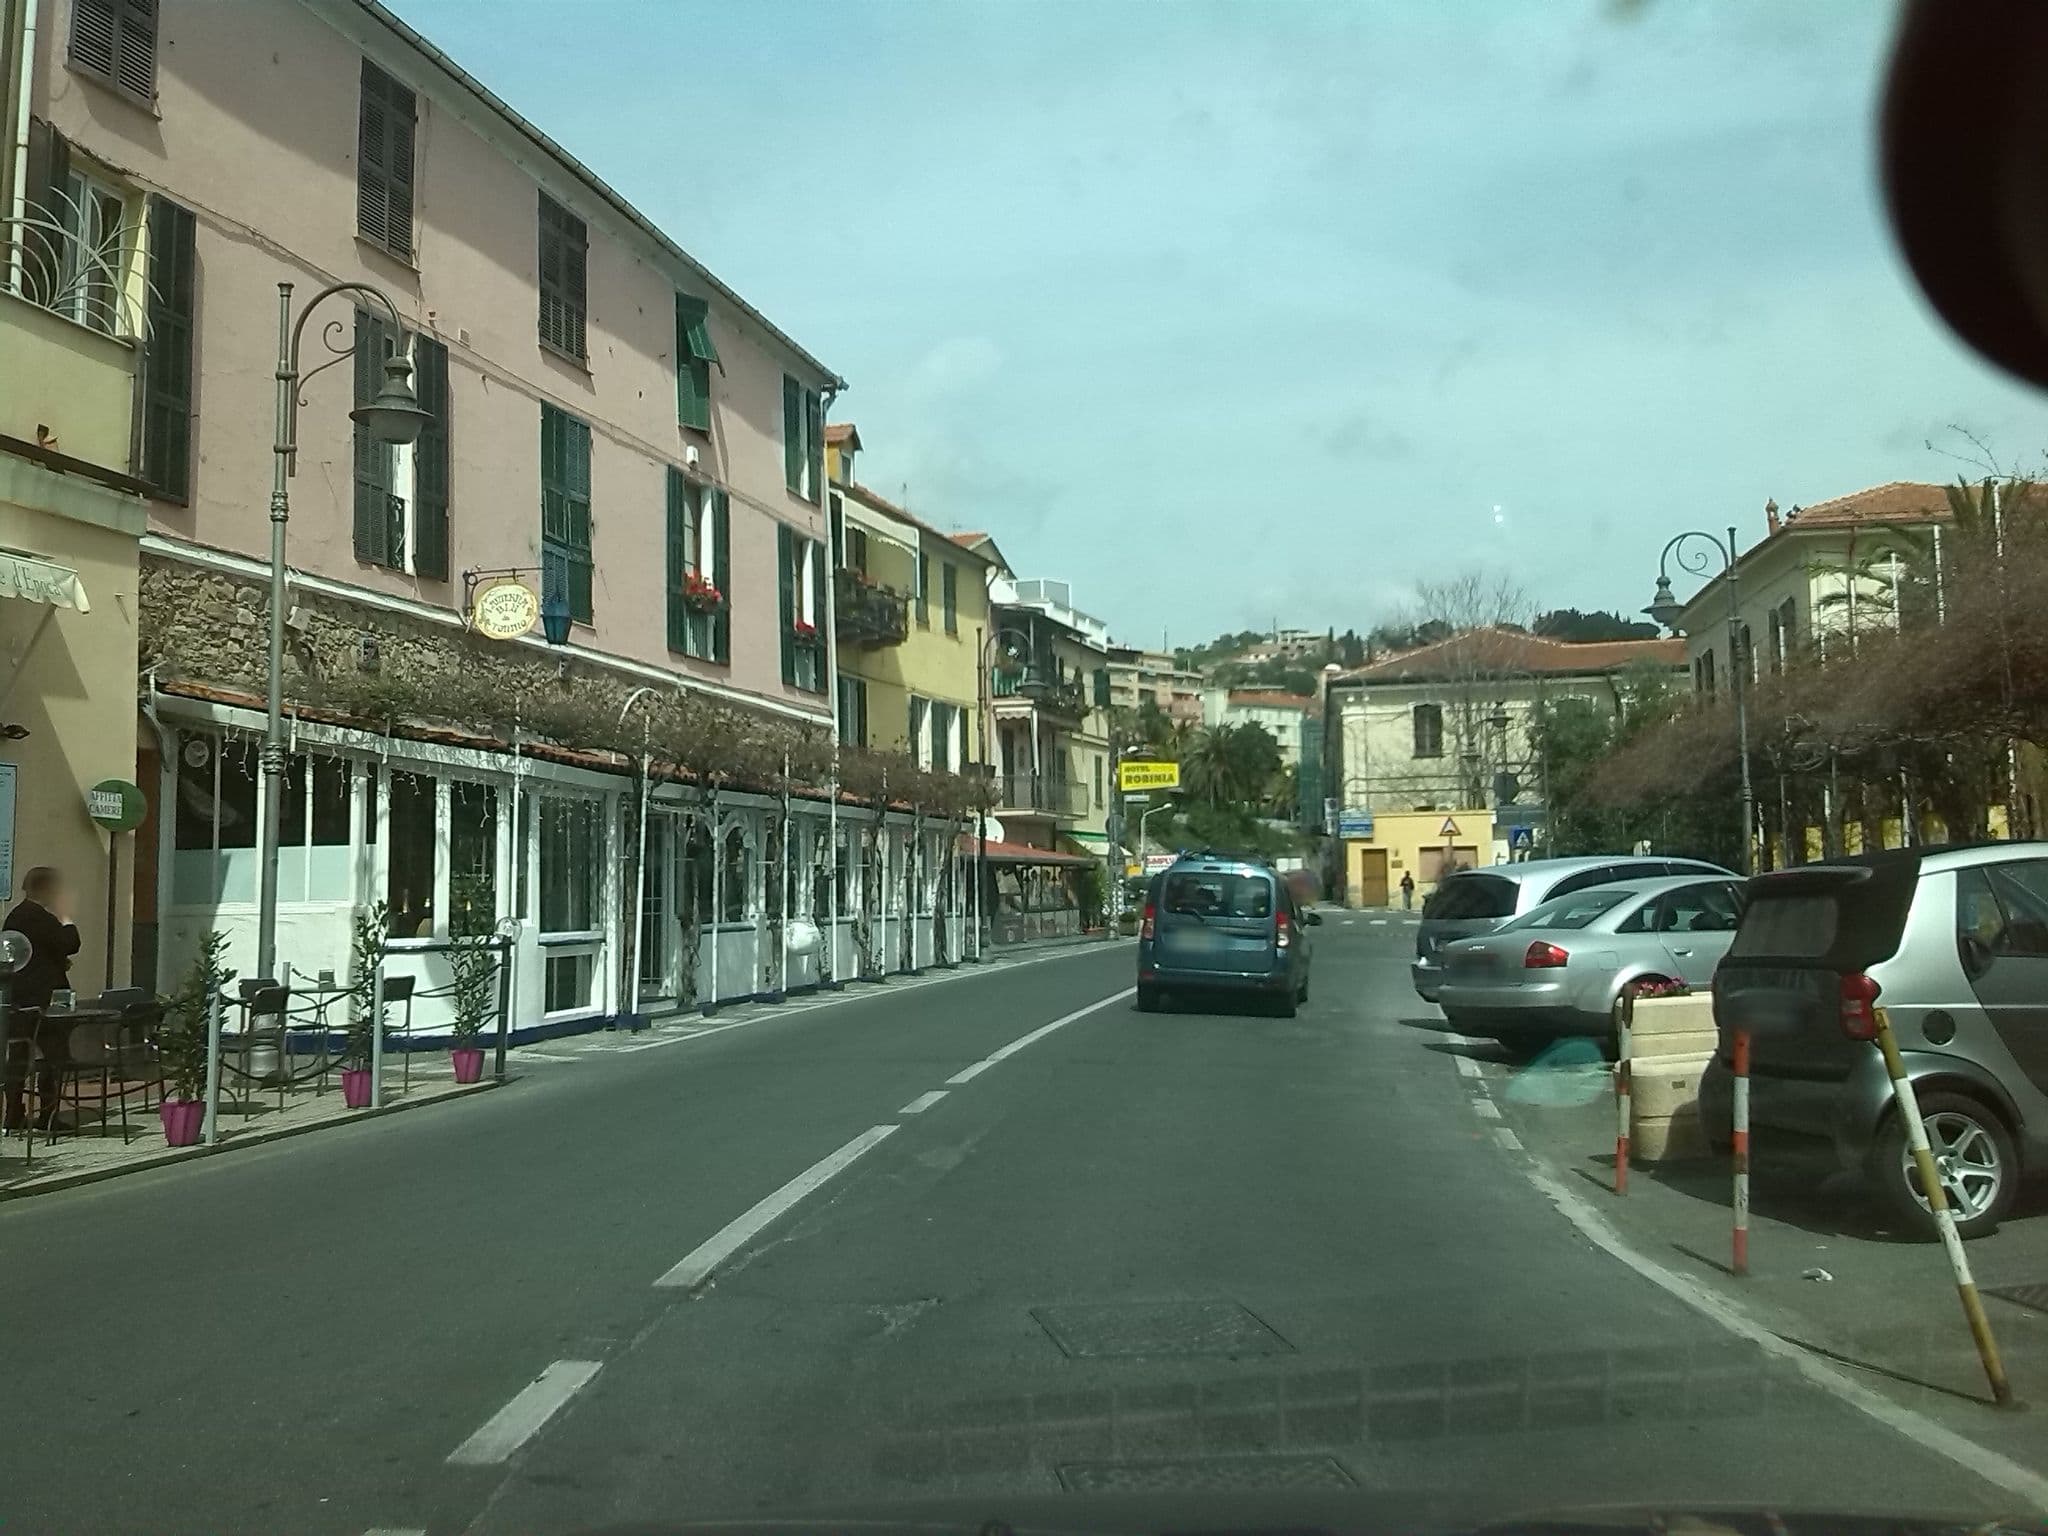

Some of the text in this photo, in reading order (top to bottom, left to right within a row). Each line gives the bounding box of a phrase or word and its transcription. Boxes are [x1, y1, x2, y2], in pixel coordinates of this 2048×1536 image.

[13, 561, 62, 599] d'Epoca
[1124, 765, 1151, 773] HOTEL
[1125, 773, 1175, 785] ROBINIA
[89, 804, 122, 816] CAMERE
